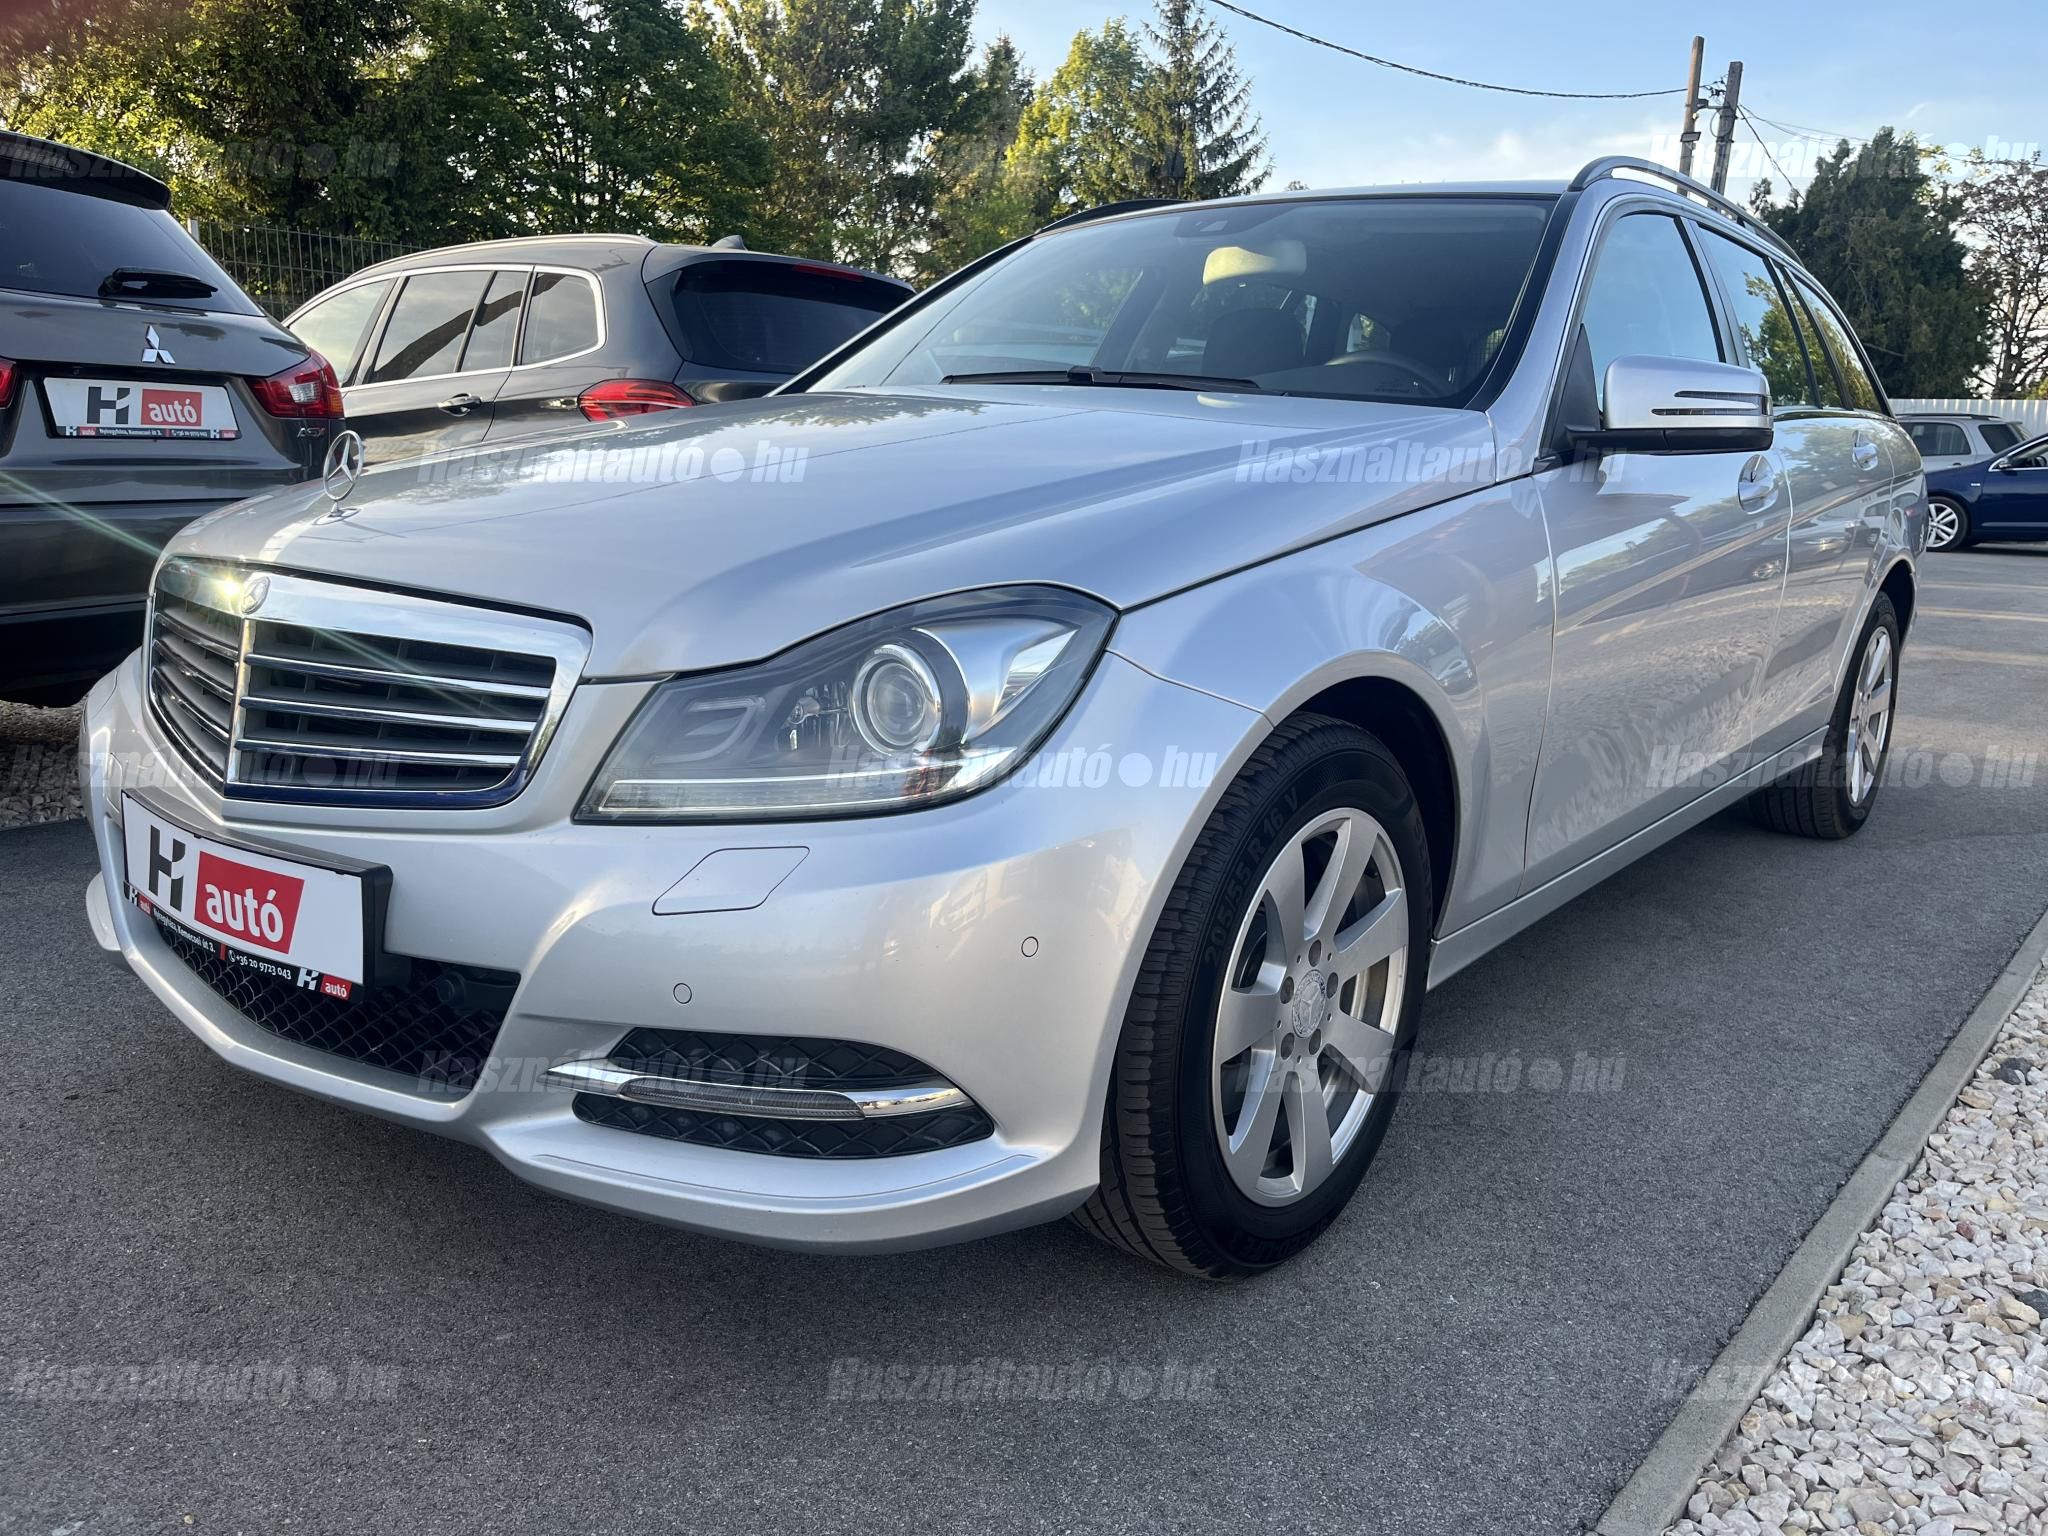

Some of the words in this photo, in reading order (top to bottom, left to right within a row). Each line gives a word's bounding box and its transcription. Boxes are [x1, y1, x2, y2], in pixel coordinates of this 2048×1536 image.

[148, 398, 198, 423] autó
[1263, 807, 1286, 840] 16
[205, 883, 284, 942] autó
[236, 954, 249, 966] +36
[249, 958, 258, 968] 20
[258, 962, 277, 975] 9723
[277, 968, 292, 980] 043
[325, 981, 348, 997] autó
